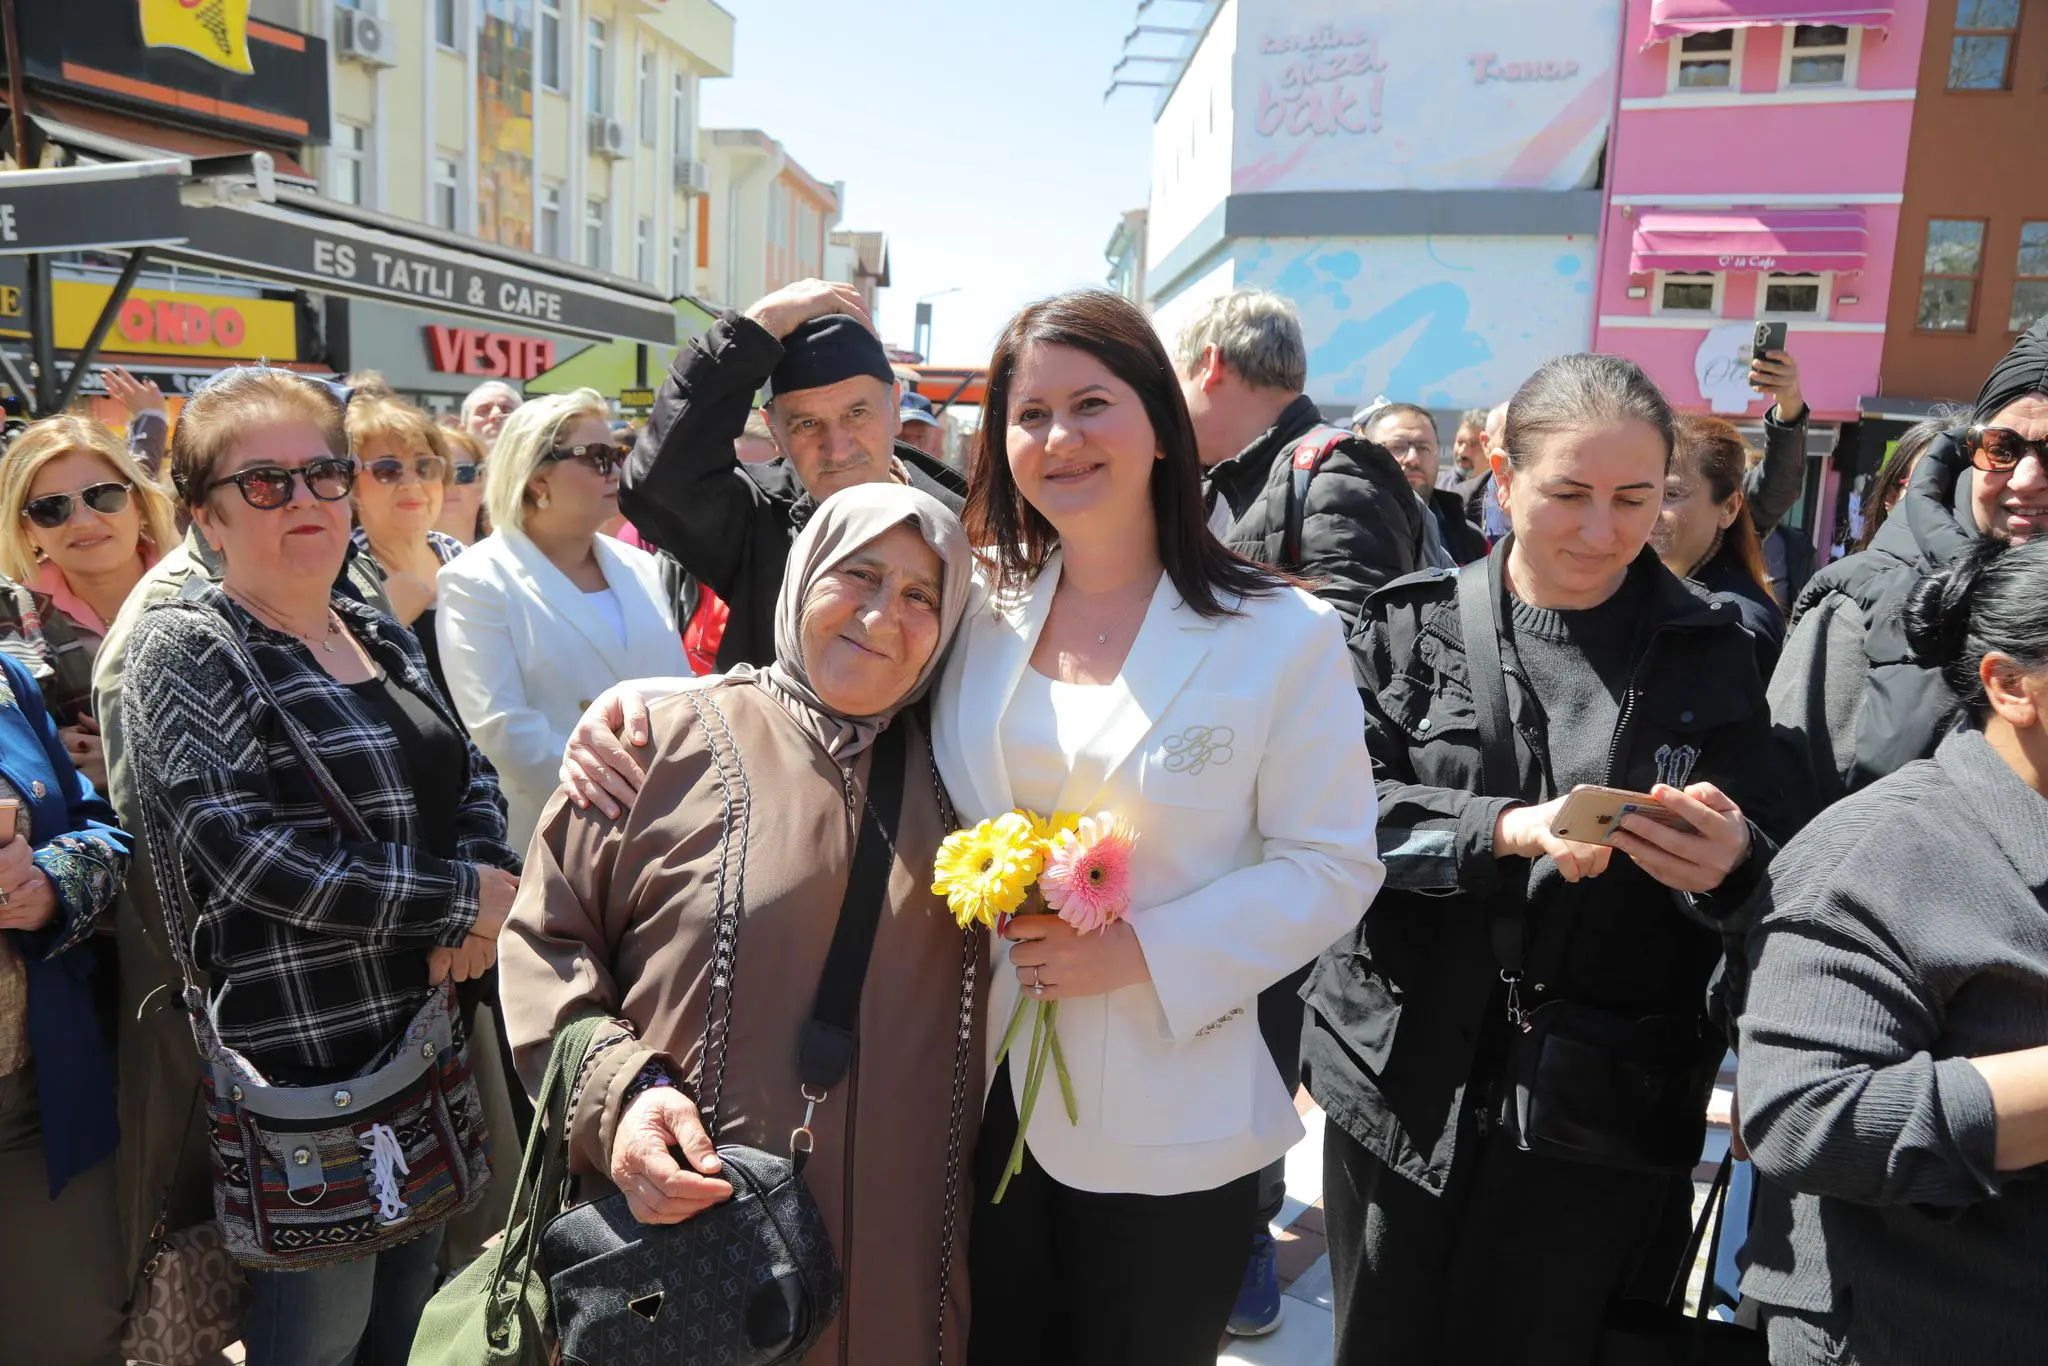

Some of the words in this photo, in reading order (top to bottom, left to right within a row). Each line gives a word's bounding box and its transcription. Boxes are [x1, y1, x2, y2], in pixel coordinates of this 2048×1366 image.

[1257, 76, 1385, 137] bak!
[0, 204, 18, 241] E
[313, 239, 356, 279] ES
[372, 252, 454, 299] TATLI
[467, 275, 486, 306] &
[499, 282, 562, 322] CAFE
[118, 298, 245, 348] ONDO
